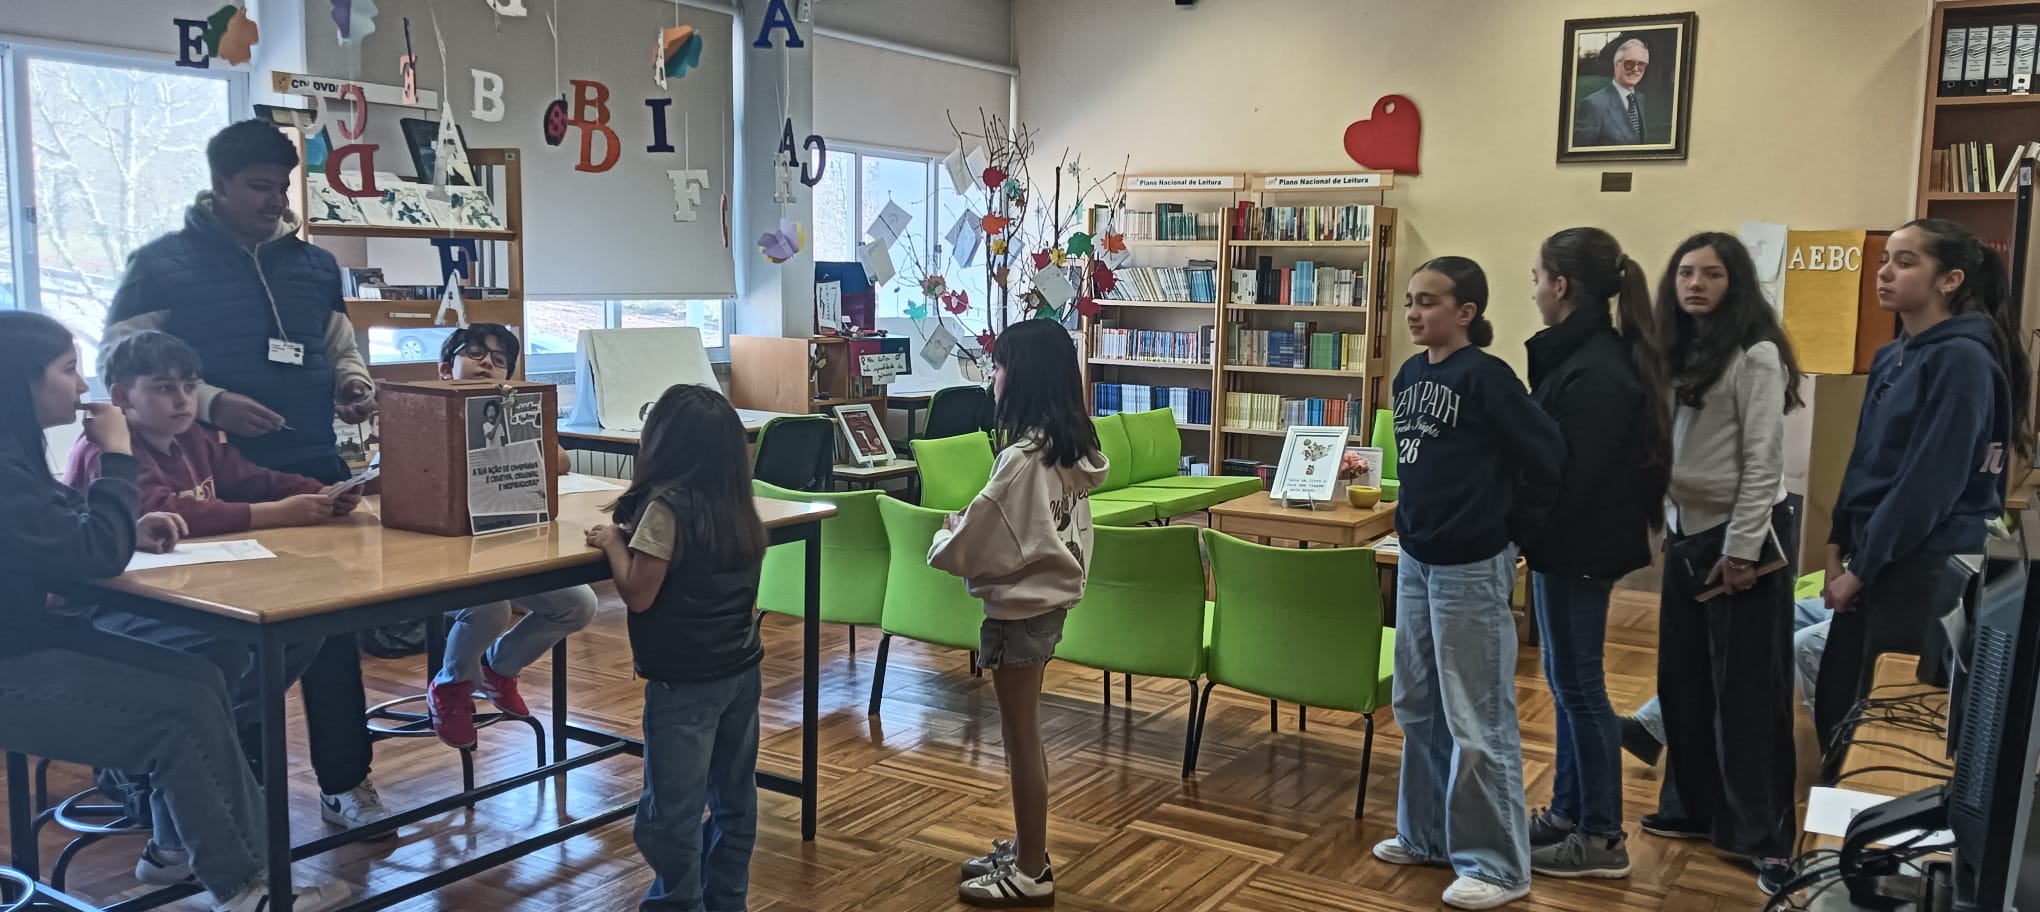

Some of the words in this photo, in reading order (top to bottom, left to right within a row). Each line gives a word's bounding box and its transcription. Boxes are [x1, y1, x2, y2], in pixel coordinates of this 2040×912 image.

[173, 18, 209, 69] E
[753, 0, 804, 48] A
[470, 68, 505, 122] B
[567, 79, 611, 127] B
[575, 122, 622, 173] D
[645, 98, 675, 153] I
[778, 117, 799, 167] A
[666, 169, 710, 222] F
[1139, 179, 1158, 187] Plano
[1299, 178, 1331, 186] Nacional
[430, 238, 478, 298] F
[1787, 245, 1862, 272] AEBC
[434, 270, 470, 330] A
[1418, 381, 1461, 430] PATH
[488, 464, 502, 475] AÇÃO
[502, 464, 510, 473] DE
[1399, 438, 1421, 464] 26
